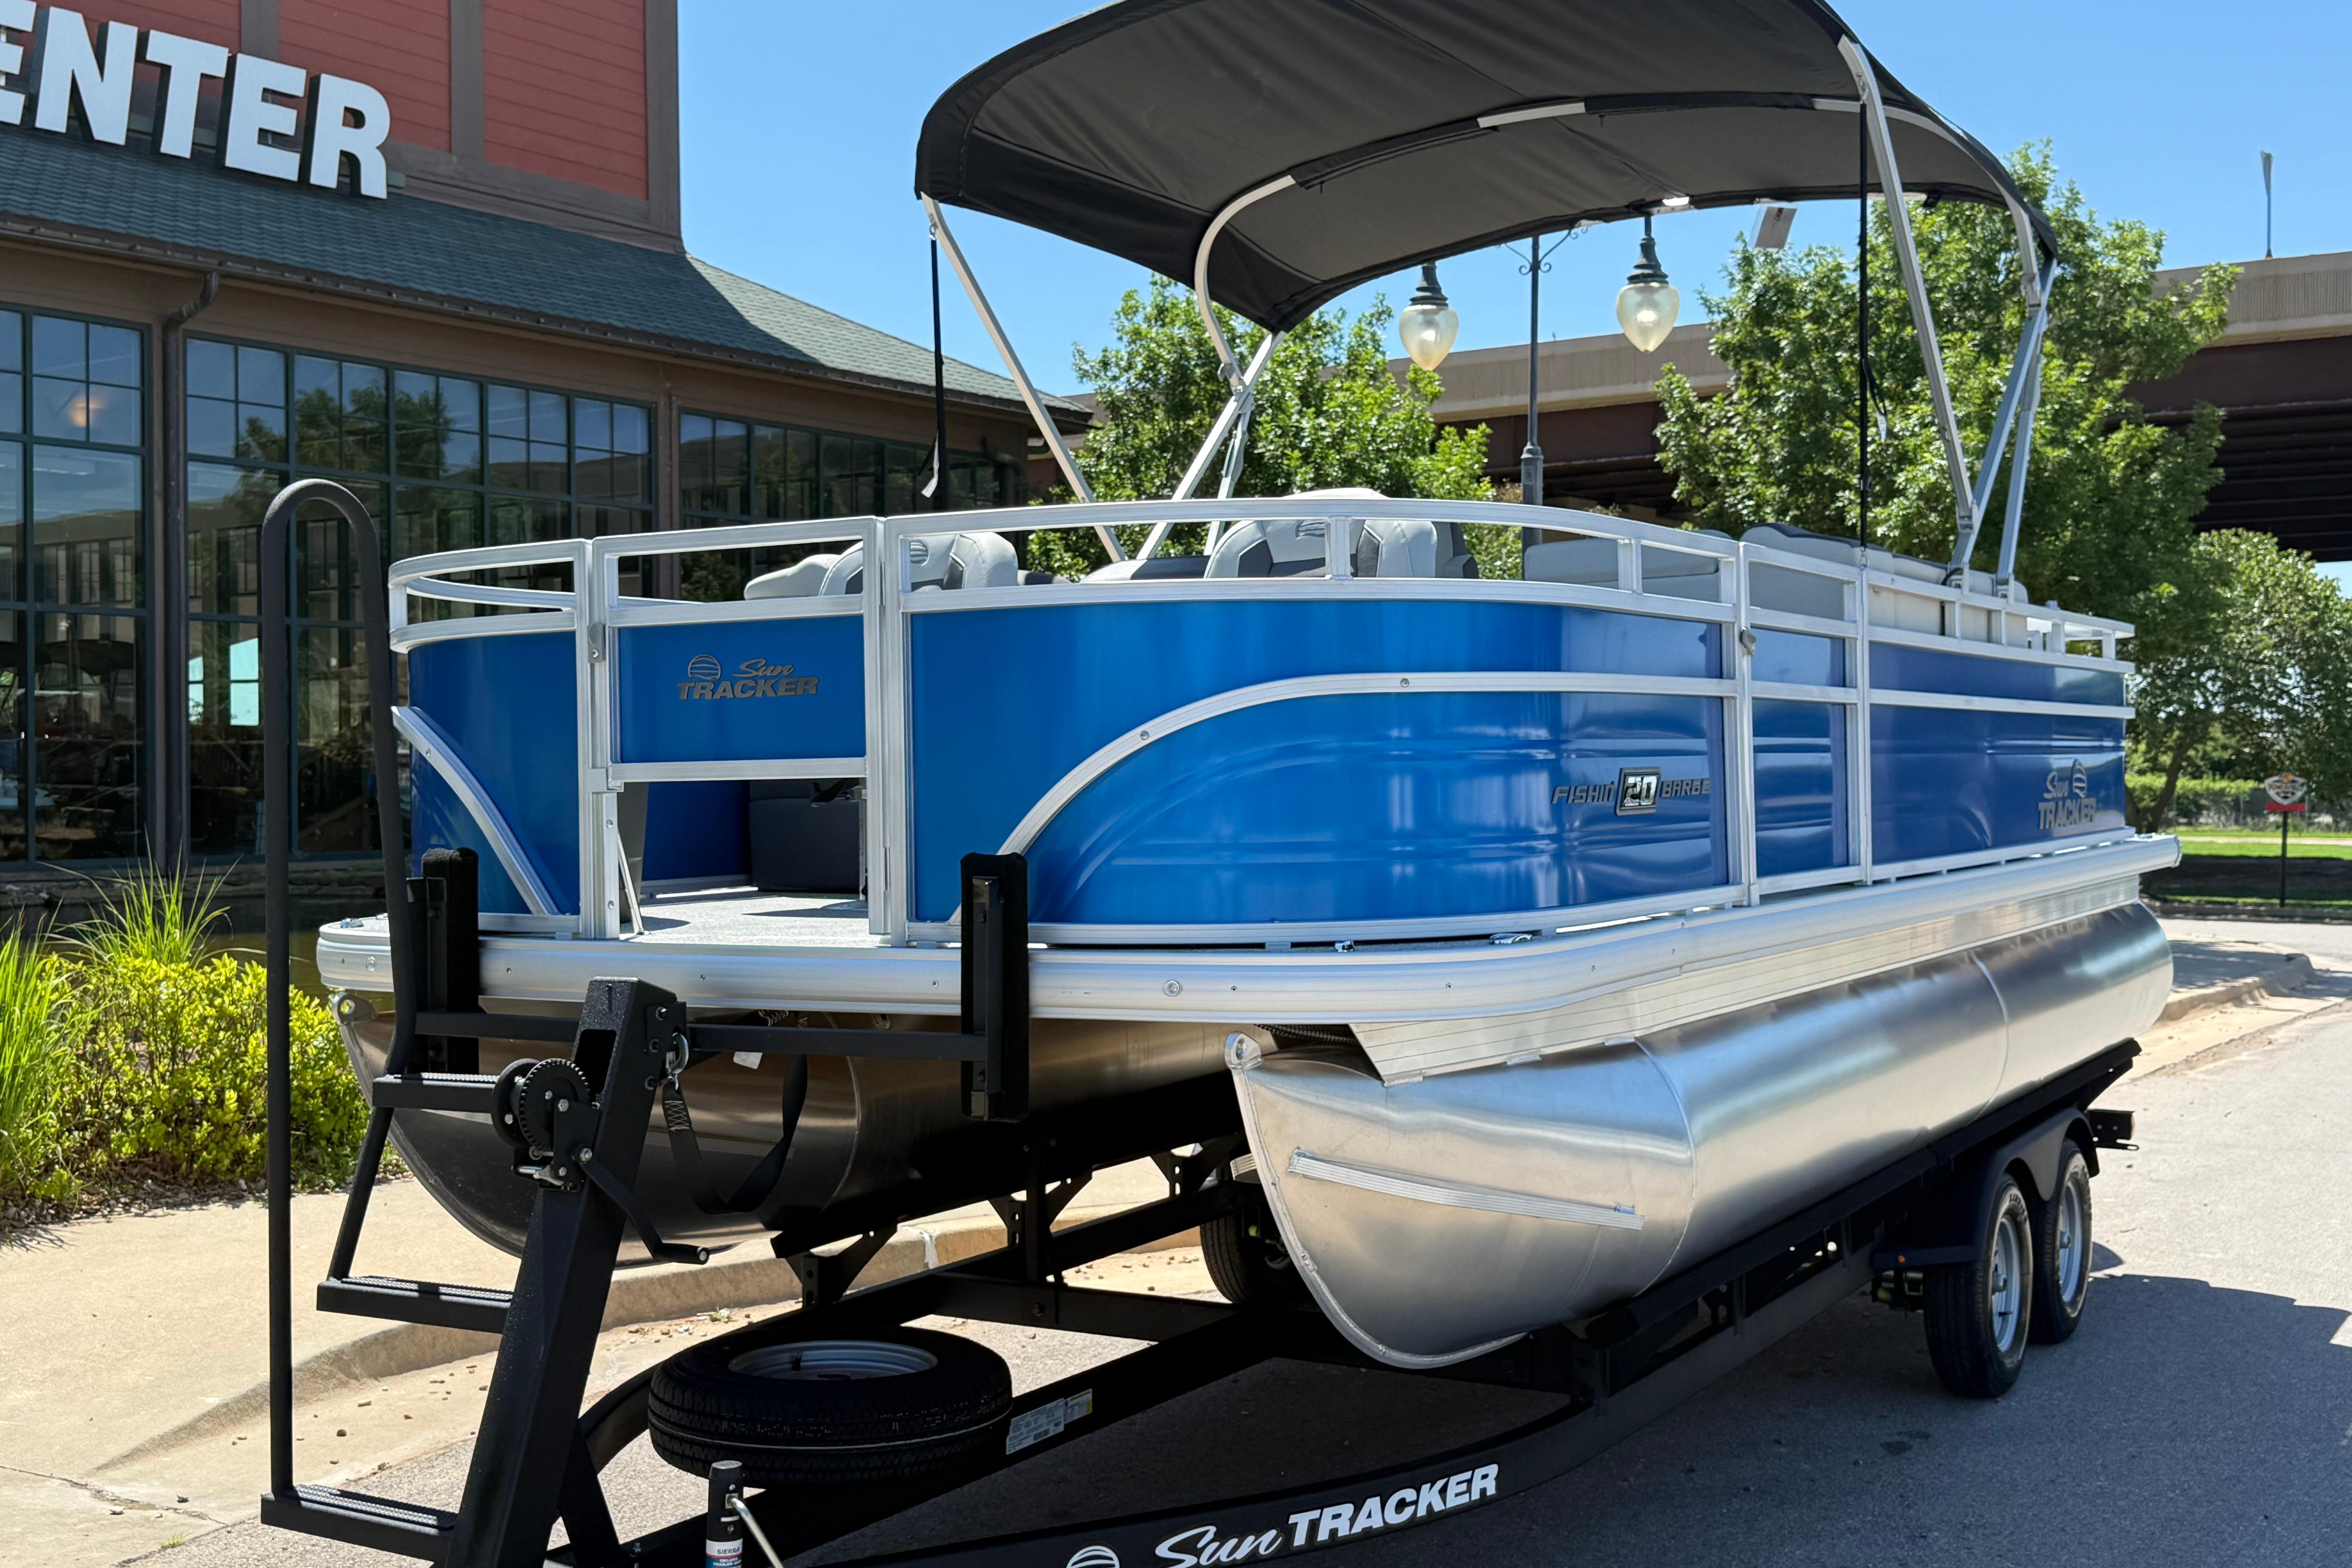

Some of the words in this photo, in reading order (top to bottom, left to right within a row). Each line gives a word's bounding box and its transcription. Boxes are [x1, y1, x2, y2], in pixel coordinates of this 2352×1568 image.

[732, 659, 794, 677] Sun
[677, 677, 818, 700] TRACKER
[1623, 775, 1657, 806] 20
[1660, 778, 1710, 797] BARGE
[2043, 771, 2069, 799] Sun
[2038, 797, 2097, 830] TRACKER
[1155, 1526, 1282, 1568] Sun
[1288, 1463, 1498, 1547] TRACKER
[717, 1546, 740, 1554] SIERRA
